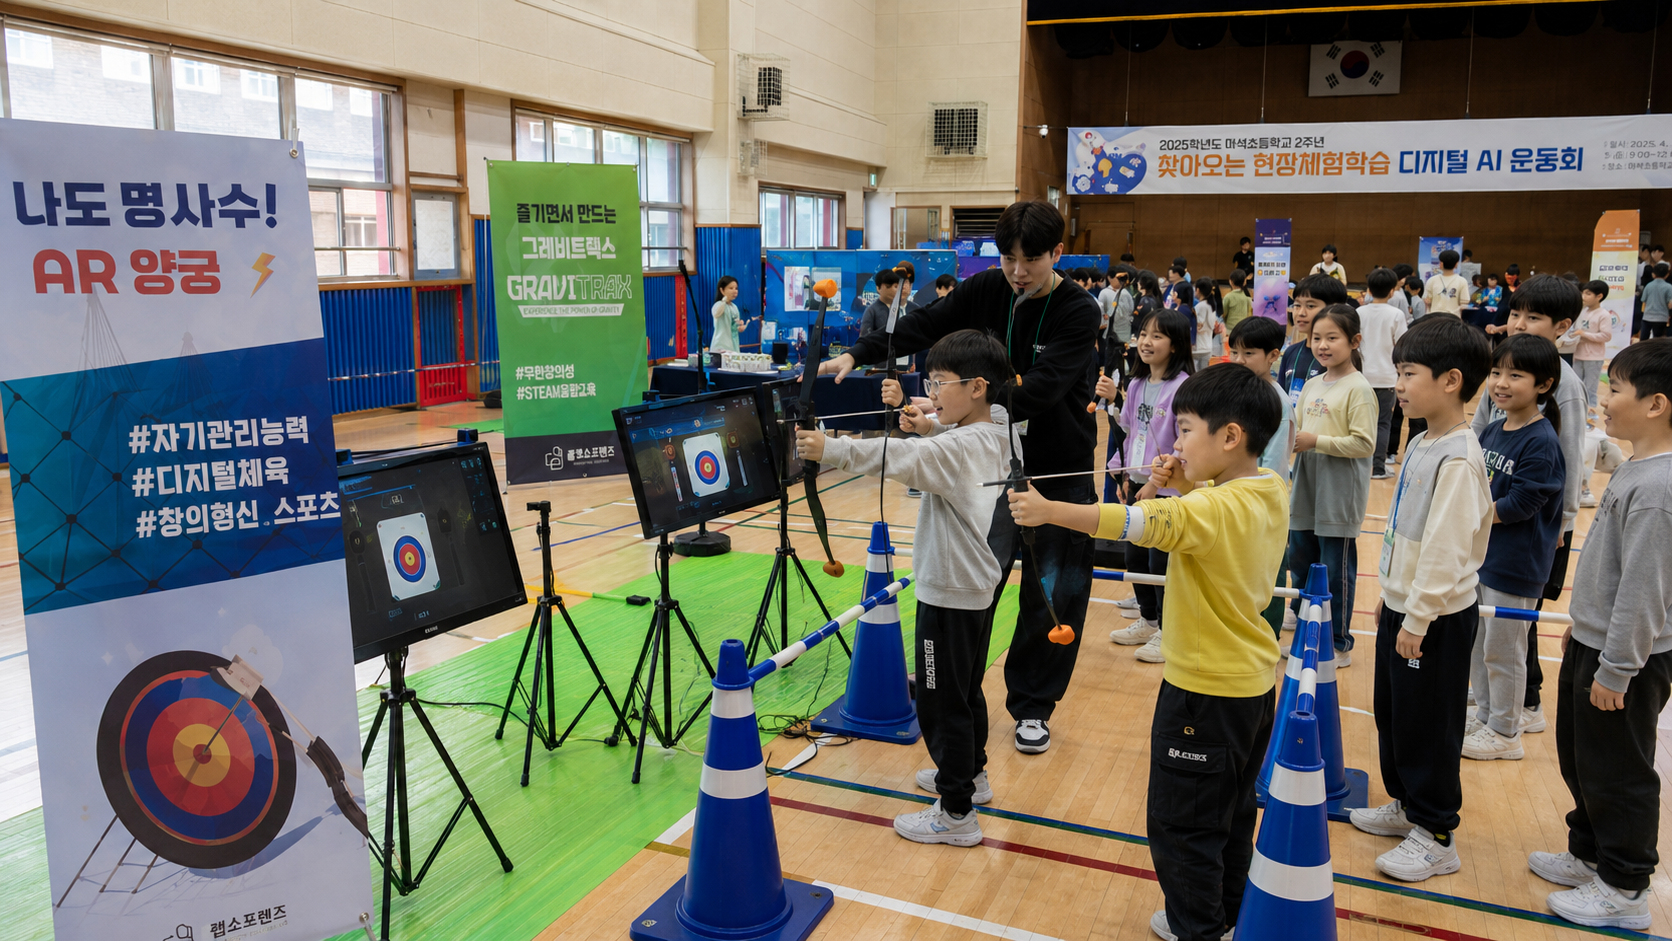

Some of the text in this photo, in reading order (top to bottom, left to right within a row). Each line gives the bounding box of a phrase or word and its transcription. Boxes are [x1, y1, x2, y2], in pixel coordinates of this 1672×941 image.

[1159, 136, 1325, 150] 2025학년도 마석초등학교 2주년
[1158, 146, 1584, 178] 찾아오는 현장체험학습 디지털 AI 운동회
[12, 181, 278, 229] 나도 명사수!
[516, 203, 617, 224] 즐기면서 만드는
[32, 248, 221, 295] AR 양궁
[507, 274, 633, 300] GRAVITRAX
[128, 415, 310, 454] #자기관리능력
[132, 456, 289, 497] #디지털체육
[274, 491, 341, 525] 스포츠
[210, 904, 287, 939] 랩소포렌즈
